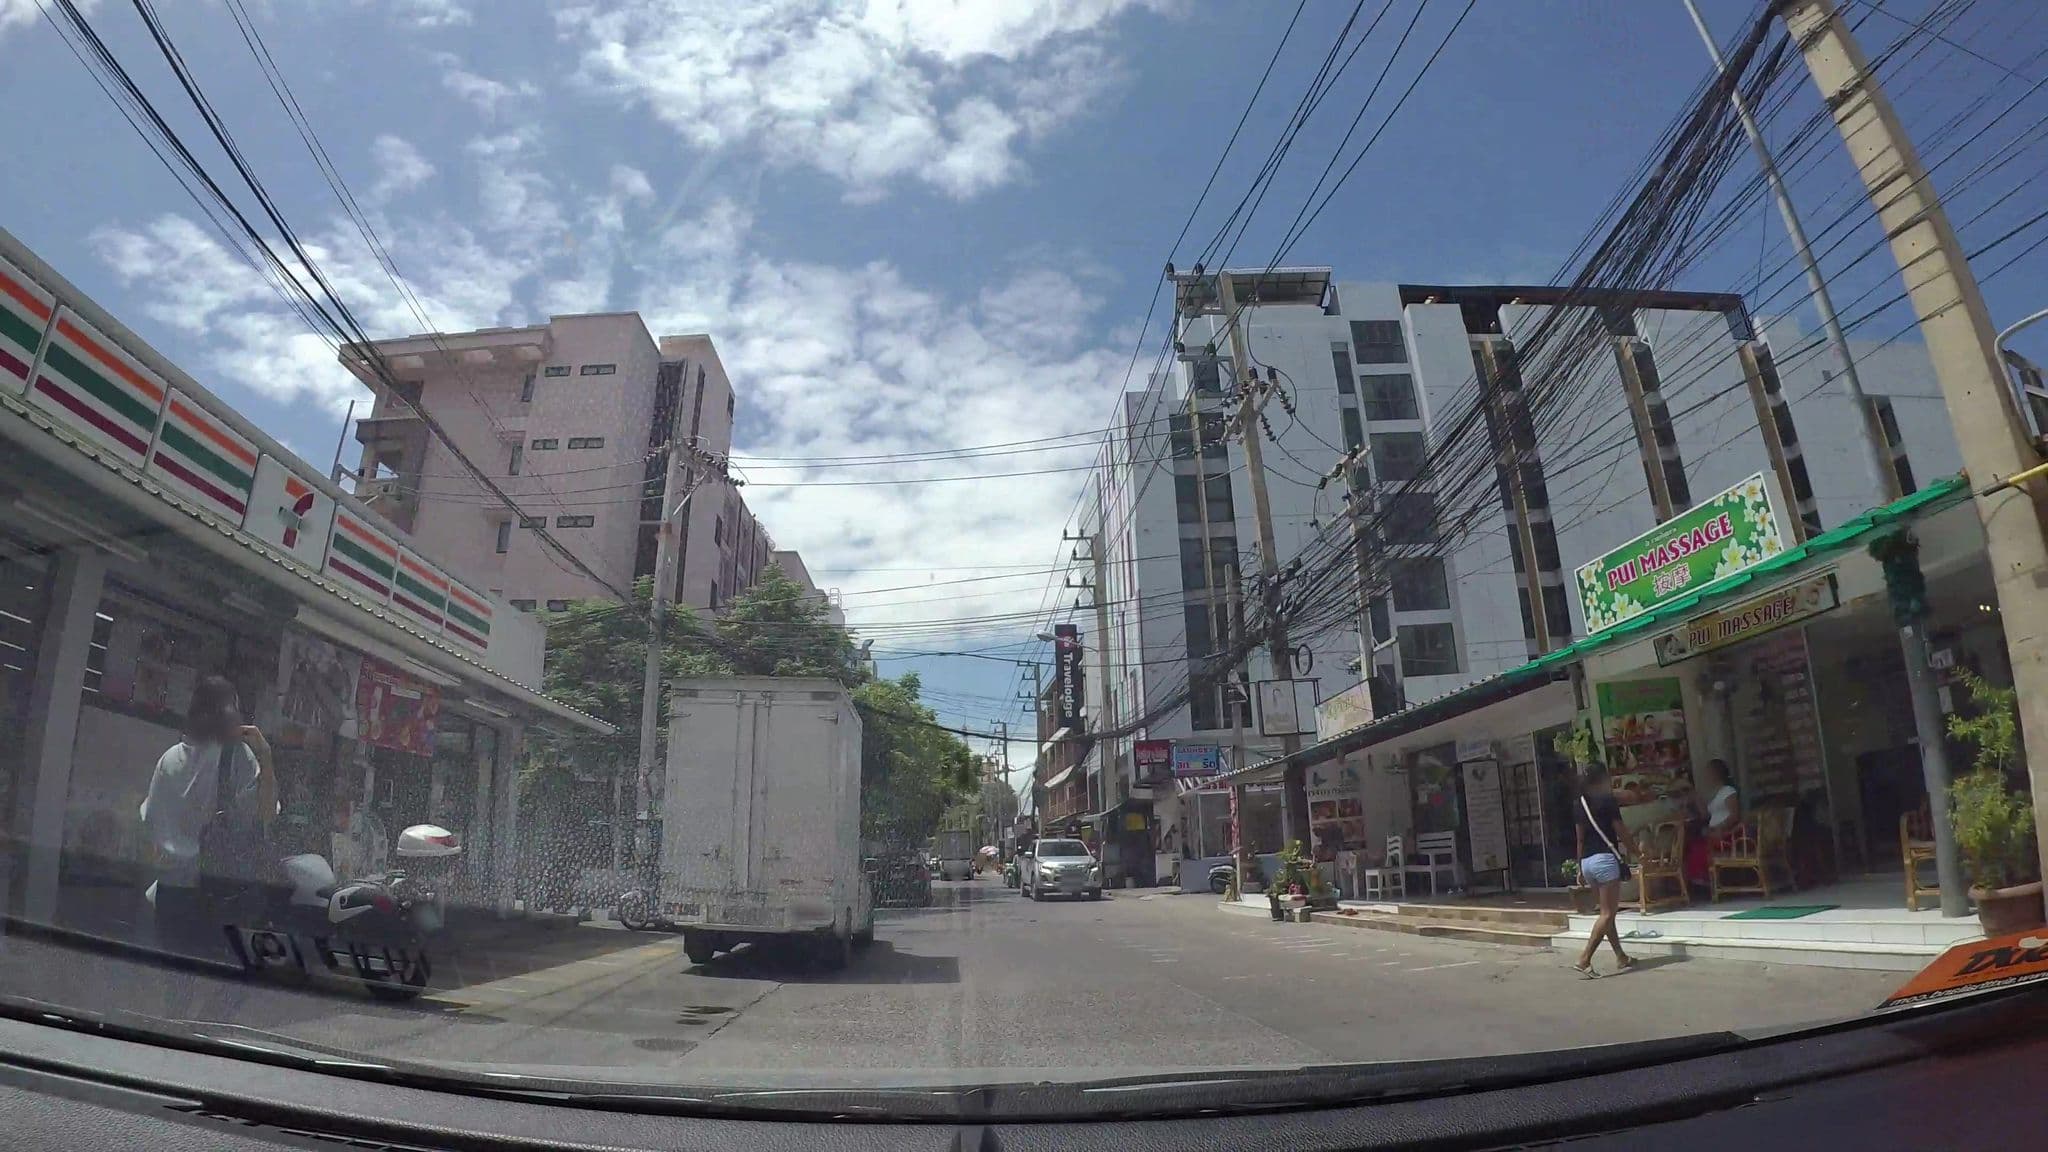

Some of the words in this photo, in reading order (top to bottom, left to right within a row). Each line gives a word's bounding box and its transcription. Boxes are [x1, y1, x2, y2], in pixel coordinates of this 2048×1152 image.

[1607, 559, 1637, 590] PUI
[1639, 512, 1734, 574] MASSAGE
[1654, 563, 1692, 597] 按摩
[1688, 624, 1712, 648] PUI
[1716, 597, 1794, 640] MASSAGE
[1061, 652, 1074, 718] Travelodge
